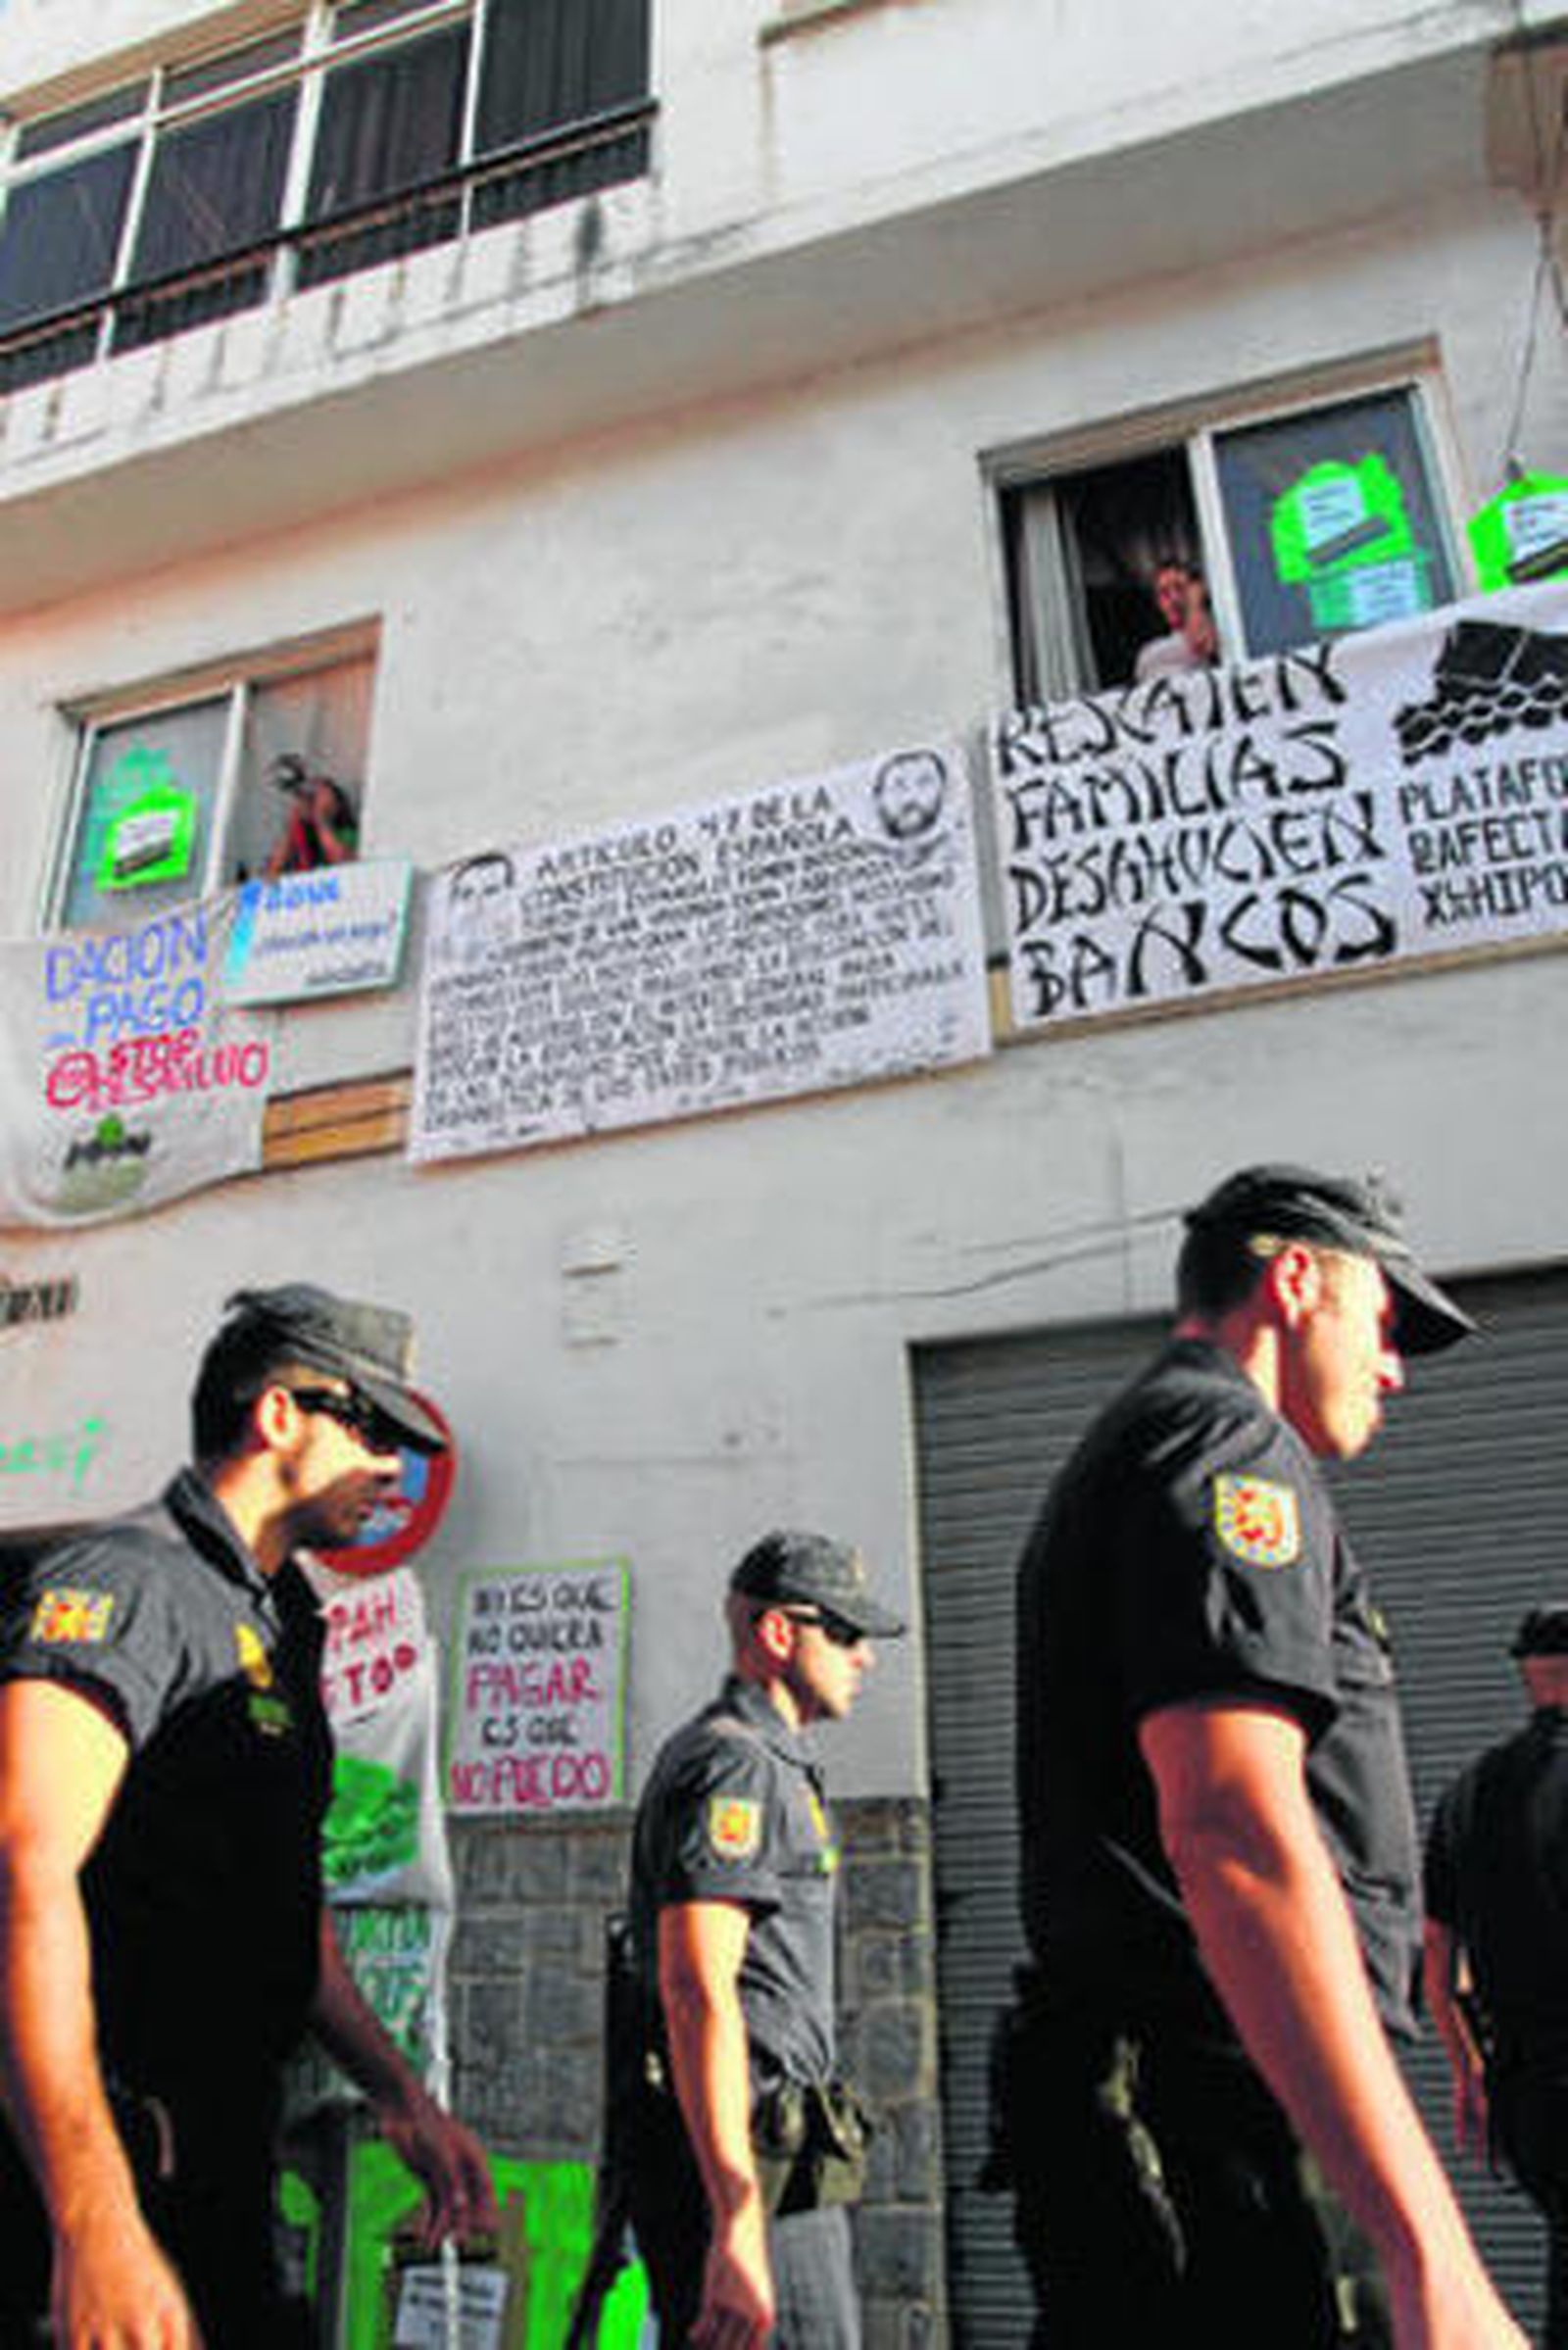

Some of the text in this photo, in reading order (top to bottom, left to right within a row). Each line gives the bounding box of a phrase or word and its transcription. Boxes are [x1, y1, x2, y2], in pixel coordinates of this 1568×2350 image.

[999, 642, 1346, 774] RESCATEN
[789, 783, 831, 820] LA
[1006, 722, 1347, 850] FAMILIAS
[1009, 792, 1383, 934] DESAHUCIEN
[1440, 802, 1568, 870] AFECT
[1021, 874, 1396, 1015] BANCOS
[82, 978, 206, 1049] PAGO
[466, 1654, 601, 1712] PAGAR
